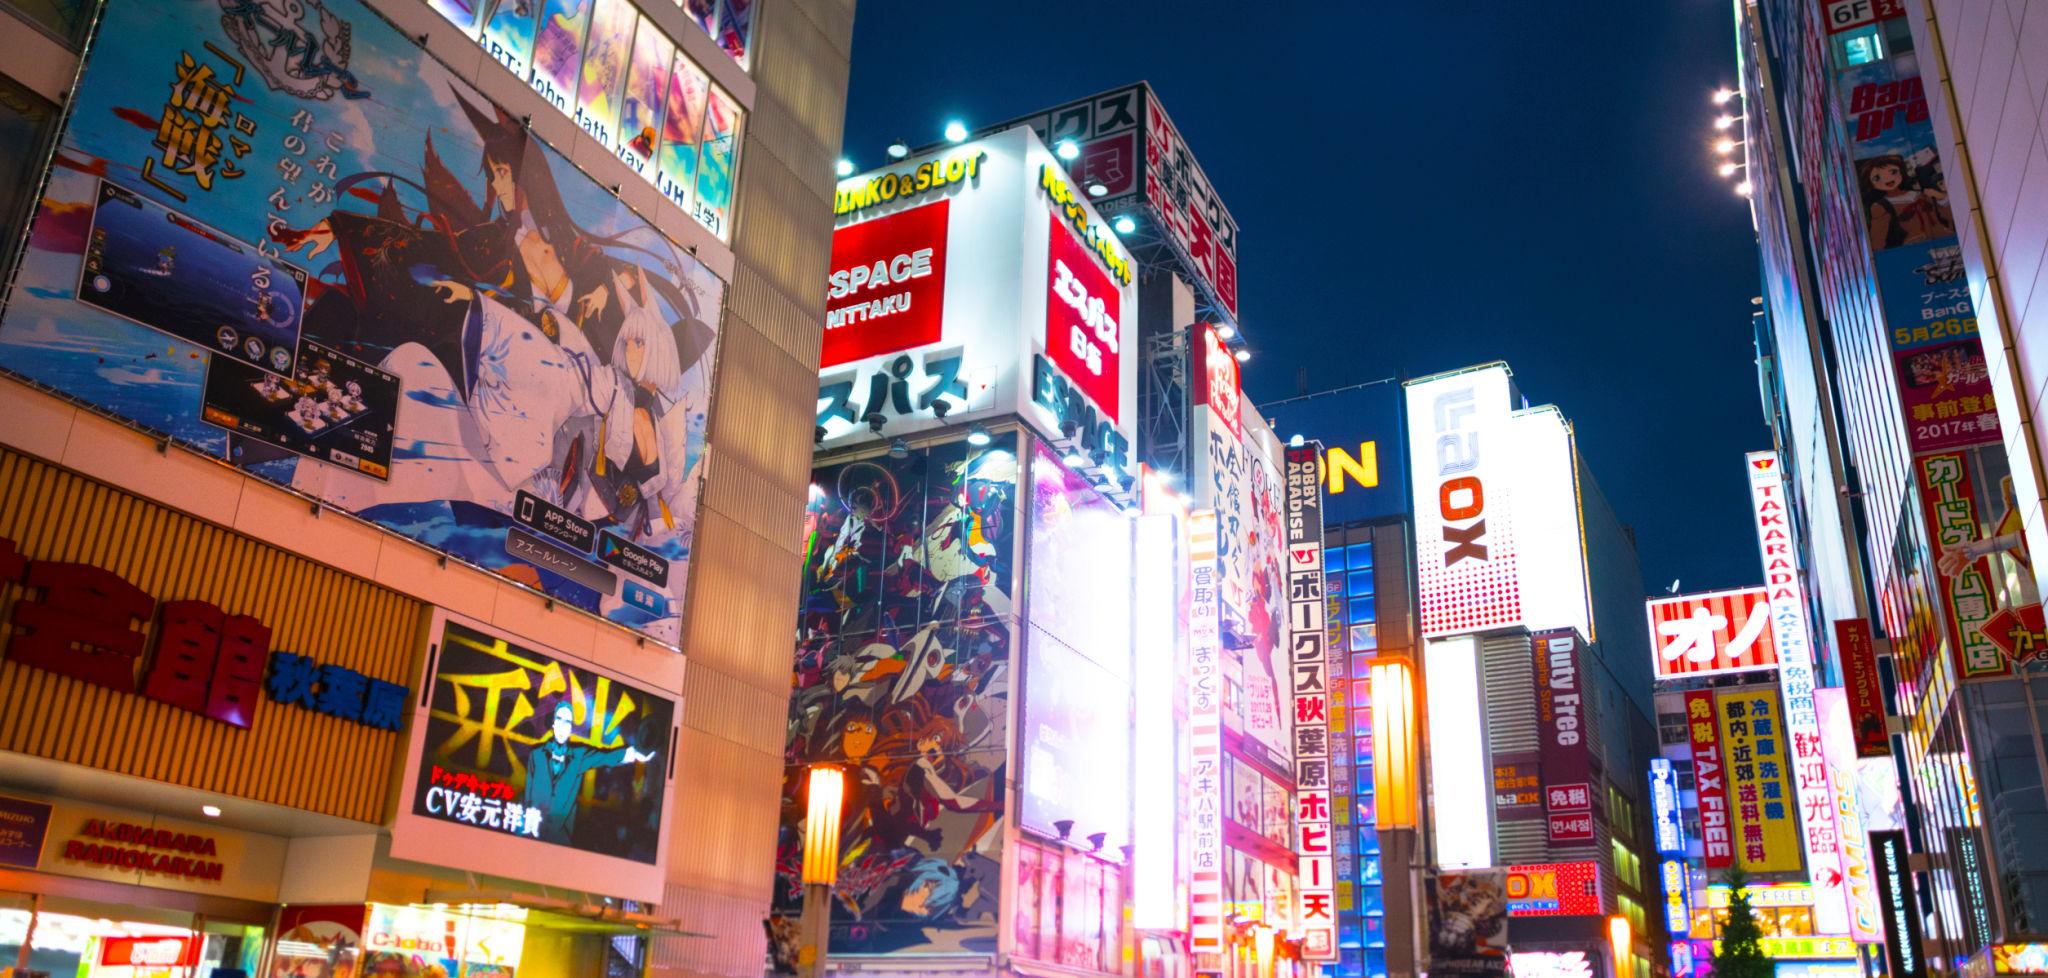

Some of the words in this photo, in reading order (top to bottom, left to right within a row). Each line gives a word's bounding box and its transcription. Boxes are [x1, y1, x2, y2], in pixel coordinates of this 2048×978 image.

[1834, 1, 1868, 24] 6F
[220, 112, 258, 179] ロマン
[306, 130, 348, 204] これが
[251, 109, 315, 290] 君の望んでいる
[1176, 147, 1235, 258] ボークス
[827, 248, 932, 298] SPACE
[826, 292, 911, 329] NITTAKU
[1052, 259, 1118, 354] エスパス
[1895, 318, 1978, 345] 5月26日
[1922, 301, 1970, 320] BanG
[1916, 412, 1999, 440] 2017年春
[1301, 449, 1317, 509] HOBBY
[1319, 441, 1379, 494] N
[1287, 450, 1304, 541] PARADISE
[545, 510, 563, 524] APP
[565, 518, 589, 538] Store
[1757, 485, 1795, 600] TAKARADA
[515, 538, 577, 572] アズールレーン
[622, 546, 648, 567] Google
[649, 558, 664, 576] Play
[1924, 457, 2001, 673] カードゲム専門店
[1658, 602, 1770, 662] オノ
[2008, 626, 2048, 658] カー
[1548, 636, 1576, 690] Duty
[265, 650, 409, 731] 秋葉原
[1553, 693, 1580, 746] Free
[1688, 698, 1715, 743] 免税
[1695, 746, 1722, 790] TAX
[1795, 731, 1838, 855] 歓迎光臨
[1550, 789, 1587, 806] 免税
[83, 818, 217, 857] AKIHABARA
[1551, 818, 1591, 834] 면세점
[1702, 796, 1730, 858] FREE
[1833, 768, 1880, 935] GAMERS
[64, 839, 224, 882] RADIOKAIKAN
[1883, 840, 1897, 873] AKIBA
[1888, 874, 1904, 909] STORE
[1894, 909, 1914, 974] ALIENWARE
